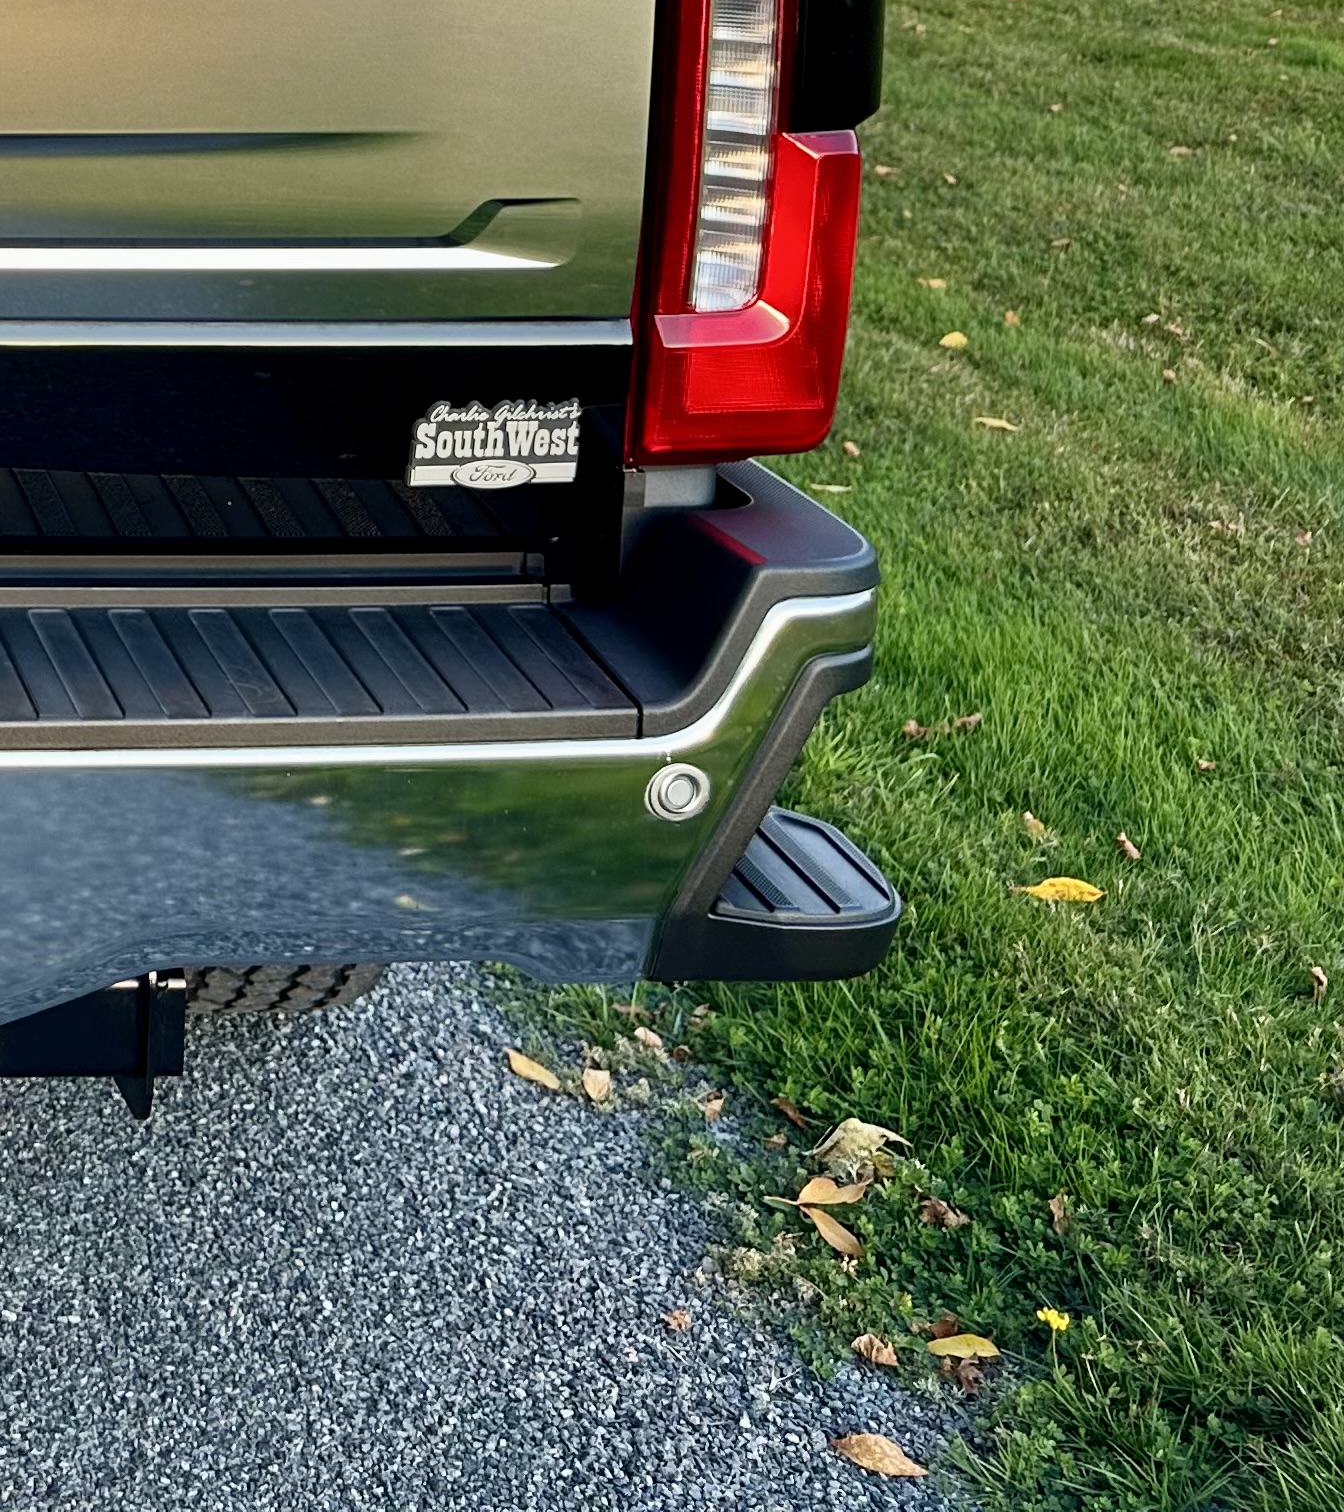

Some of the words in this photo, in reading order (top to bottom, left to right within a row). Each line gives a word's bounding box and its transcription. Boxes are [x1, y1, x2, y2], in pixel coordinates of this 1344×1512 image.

[430, 405, 490, 423] Charlie
[494, 402, 582, 428] Gilchrist's
[469, 464, 516, 483] Ford
